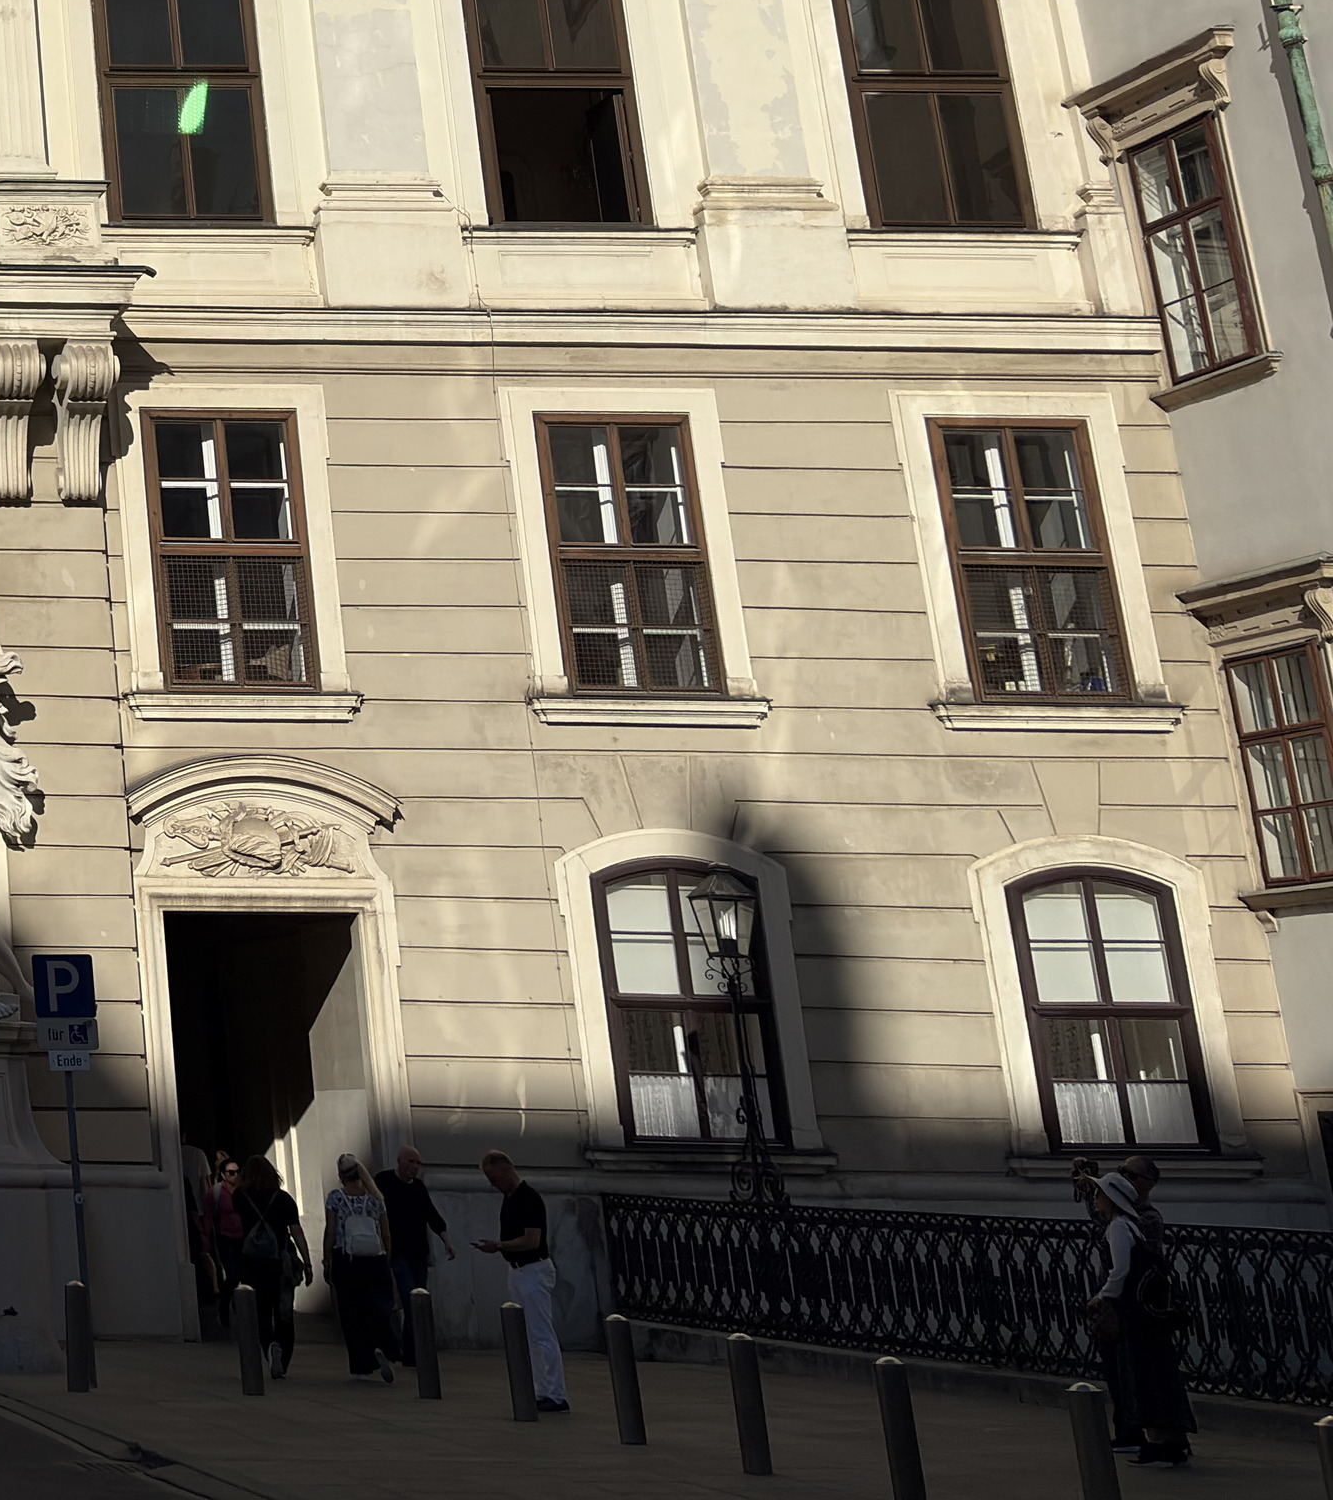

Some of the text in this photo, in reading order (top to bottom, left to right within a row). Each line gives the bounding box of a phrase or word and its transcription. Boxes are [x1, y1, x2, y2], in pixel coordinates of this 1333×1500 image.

[46, 960, 80, 1012] P
[47, 1027, 65, 1041] für
[56, 1054, 82, 1067] Ende
